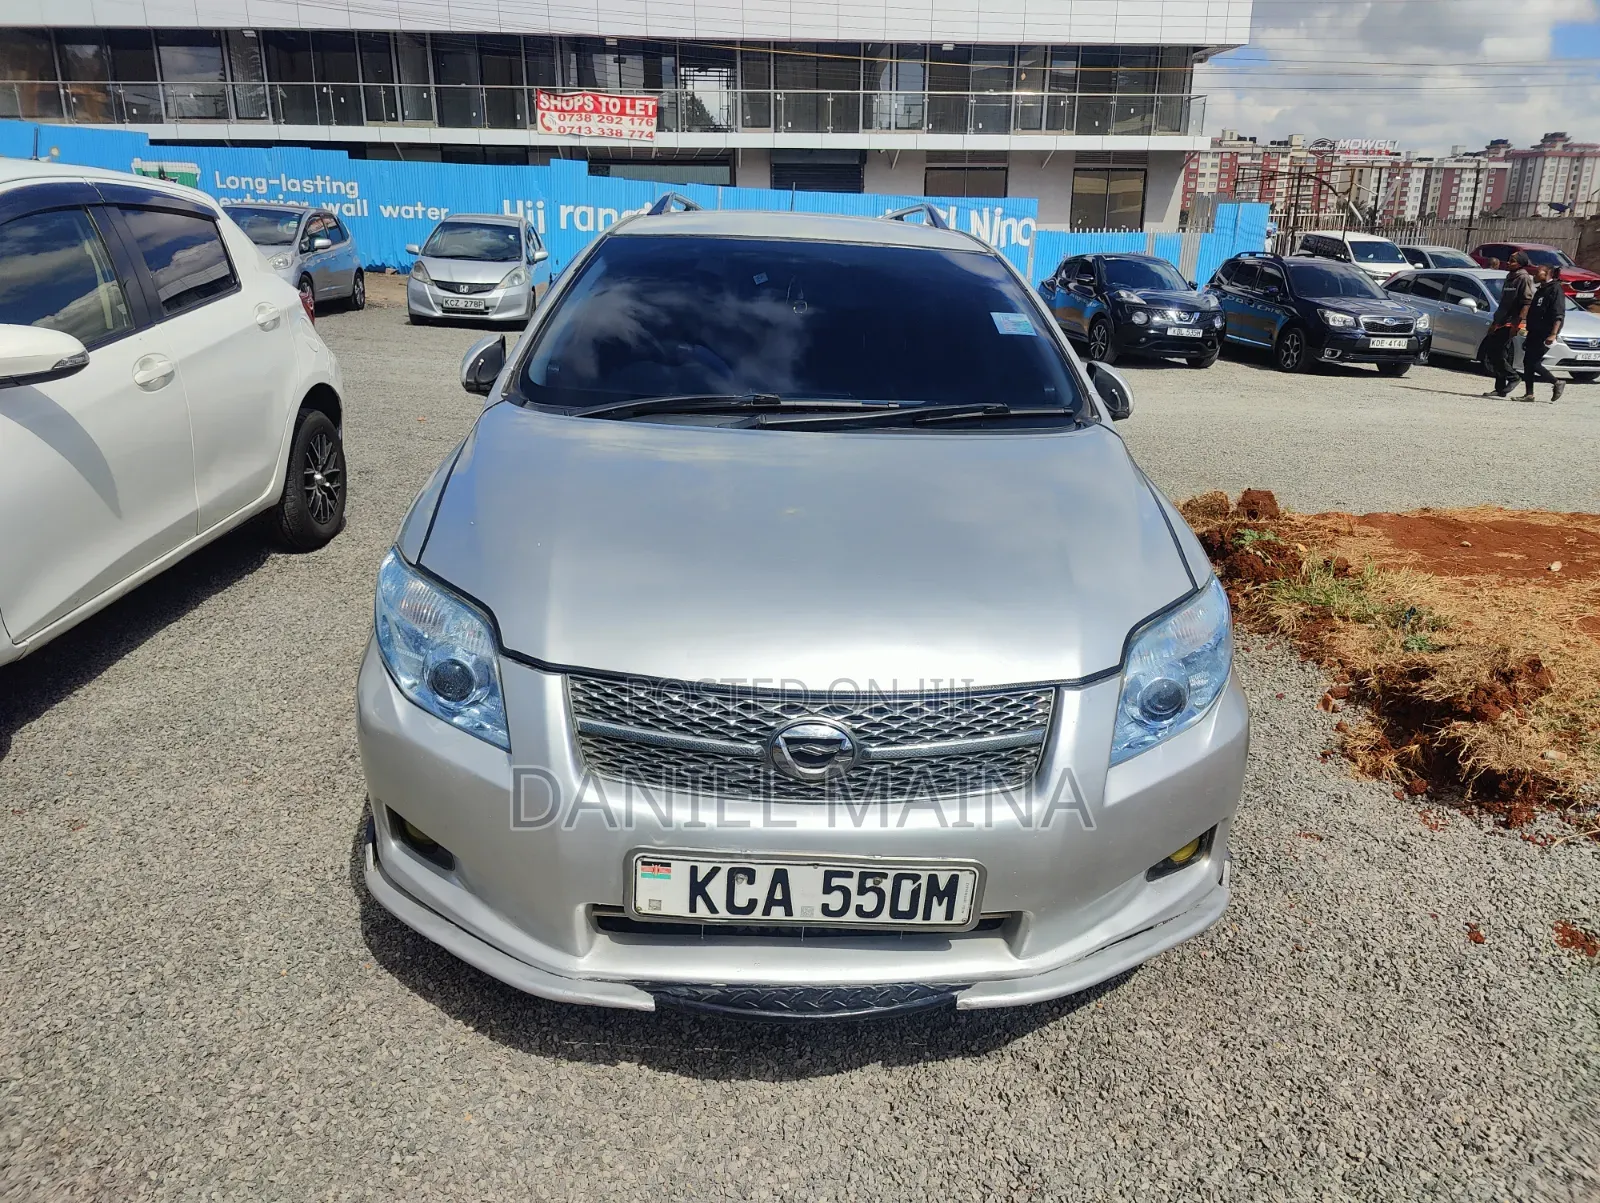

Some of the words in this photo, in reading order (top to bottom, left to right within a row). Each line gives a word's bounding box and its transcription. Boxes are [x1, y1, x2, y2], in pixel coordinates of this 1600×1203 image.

[540, 94, 594, 112] SHOPS
[598, 96, 620, 114] TO
[625, 98, 656, 116] LET
[558, 113, 592, 123] 0738
[597, 115, 623, 125] 292
[629, 117, 654, 127] 176
[558, 126, 592, 135] 0713
[598, 127, 623, 137] 338
[629, 130, 654, 139] 774
[1336, 139, 1400, 151] MOWGLI
[214, 170, 359, 200] Long-lasting
[321, 199, 369, 217] wall
[379, 201, 449, 221] water
[444, 299, 460, 308] KCZ
[464, 300, 483, 309] 278P
[1371, 339, 1385, 347] KDE
[688, 864, 794, 917] KCA
[821, 869, 960, 922] 550M
